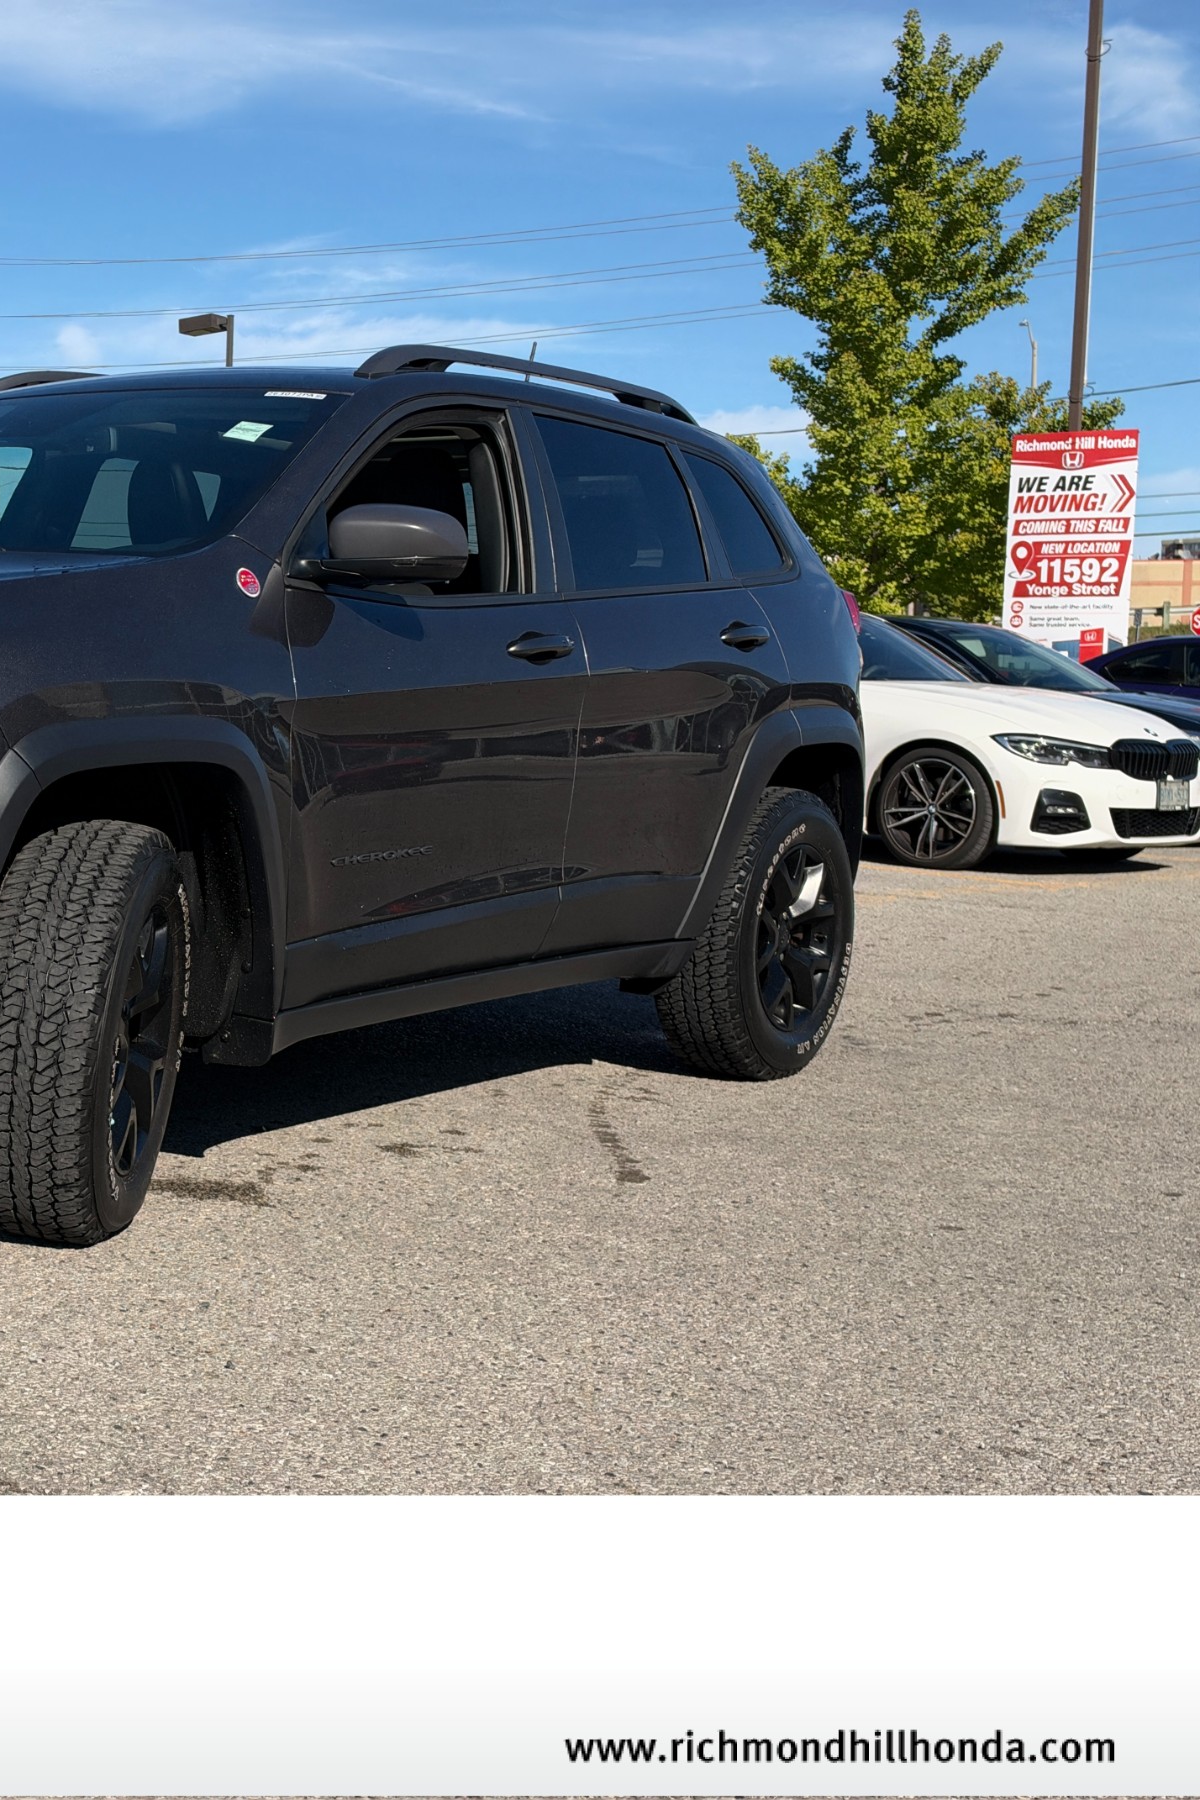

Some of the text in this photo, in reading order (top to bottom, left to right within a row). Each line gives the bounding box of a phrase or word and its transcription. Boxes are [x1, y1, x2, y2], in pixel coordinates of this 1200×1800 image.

[1016, 435, 1136, 452] Richmond Hill Honda
[1017, 475, 1096, 493] WE ARE
[1013, 493, 1107, 514] MOVING!
[1018, 518, 1125, 534] COMING THIS FALL
[1041, 542, 1121, 554] NEW LOCATION
[1037, 557, 1120, 583] 11592
[1026, 582, 1116, 597] Yonge Street
[330, 845, 433, 868] CHEROKEE
